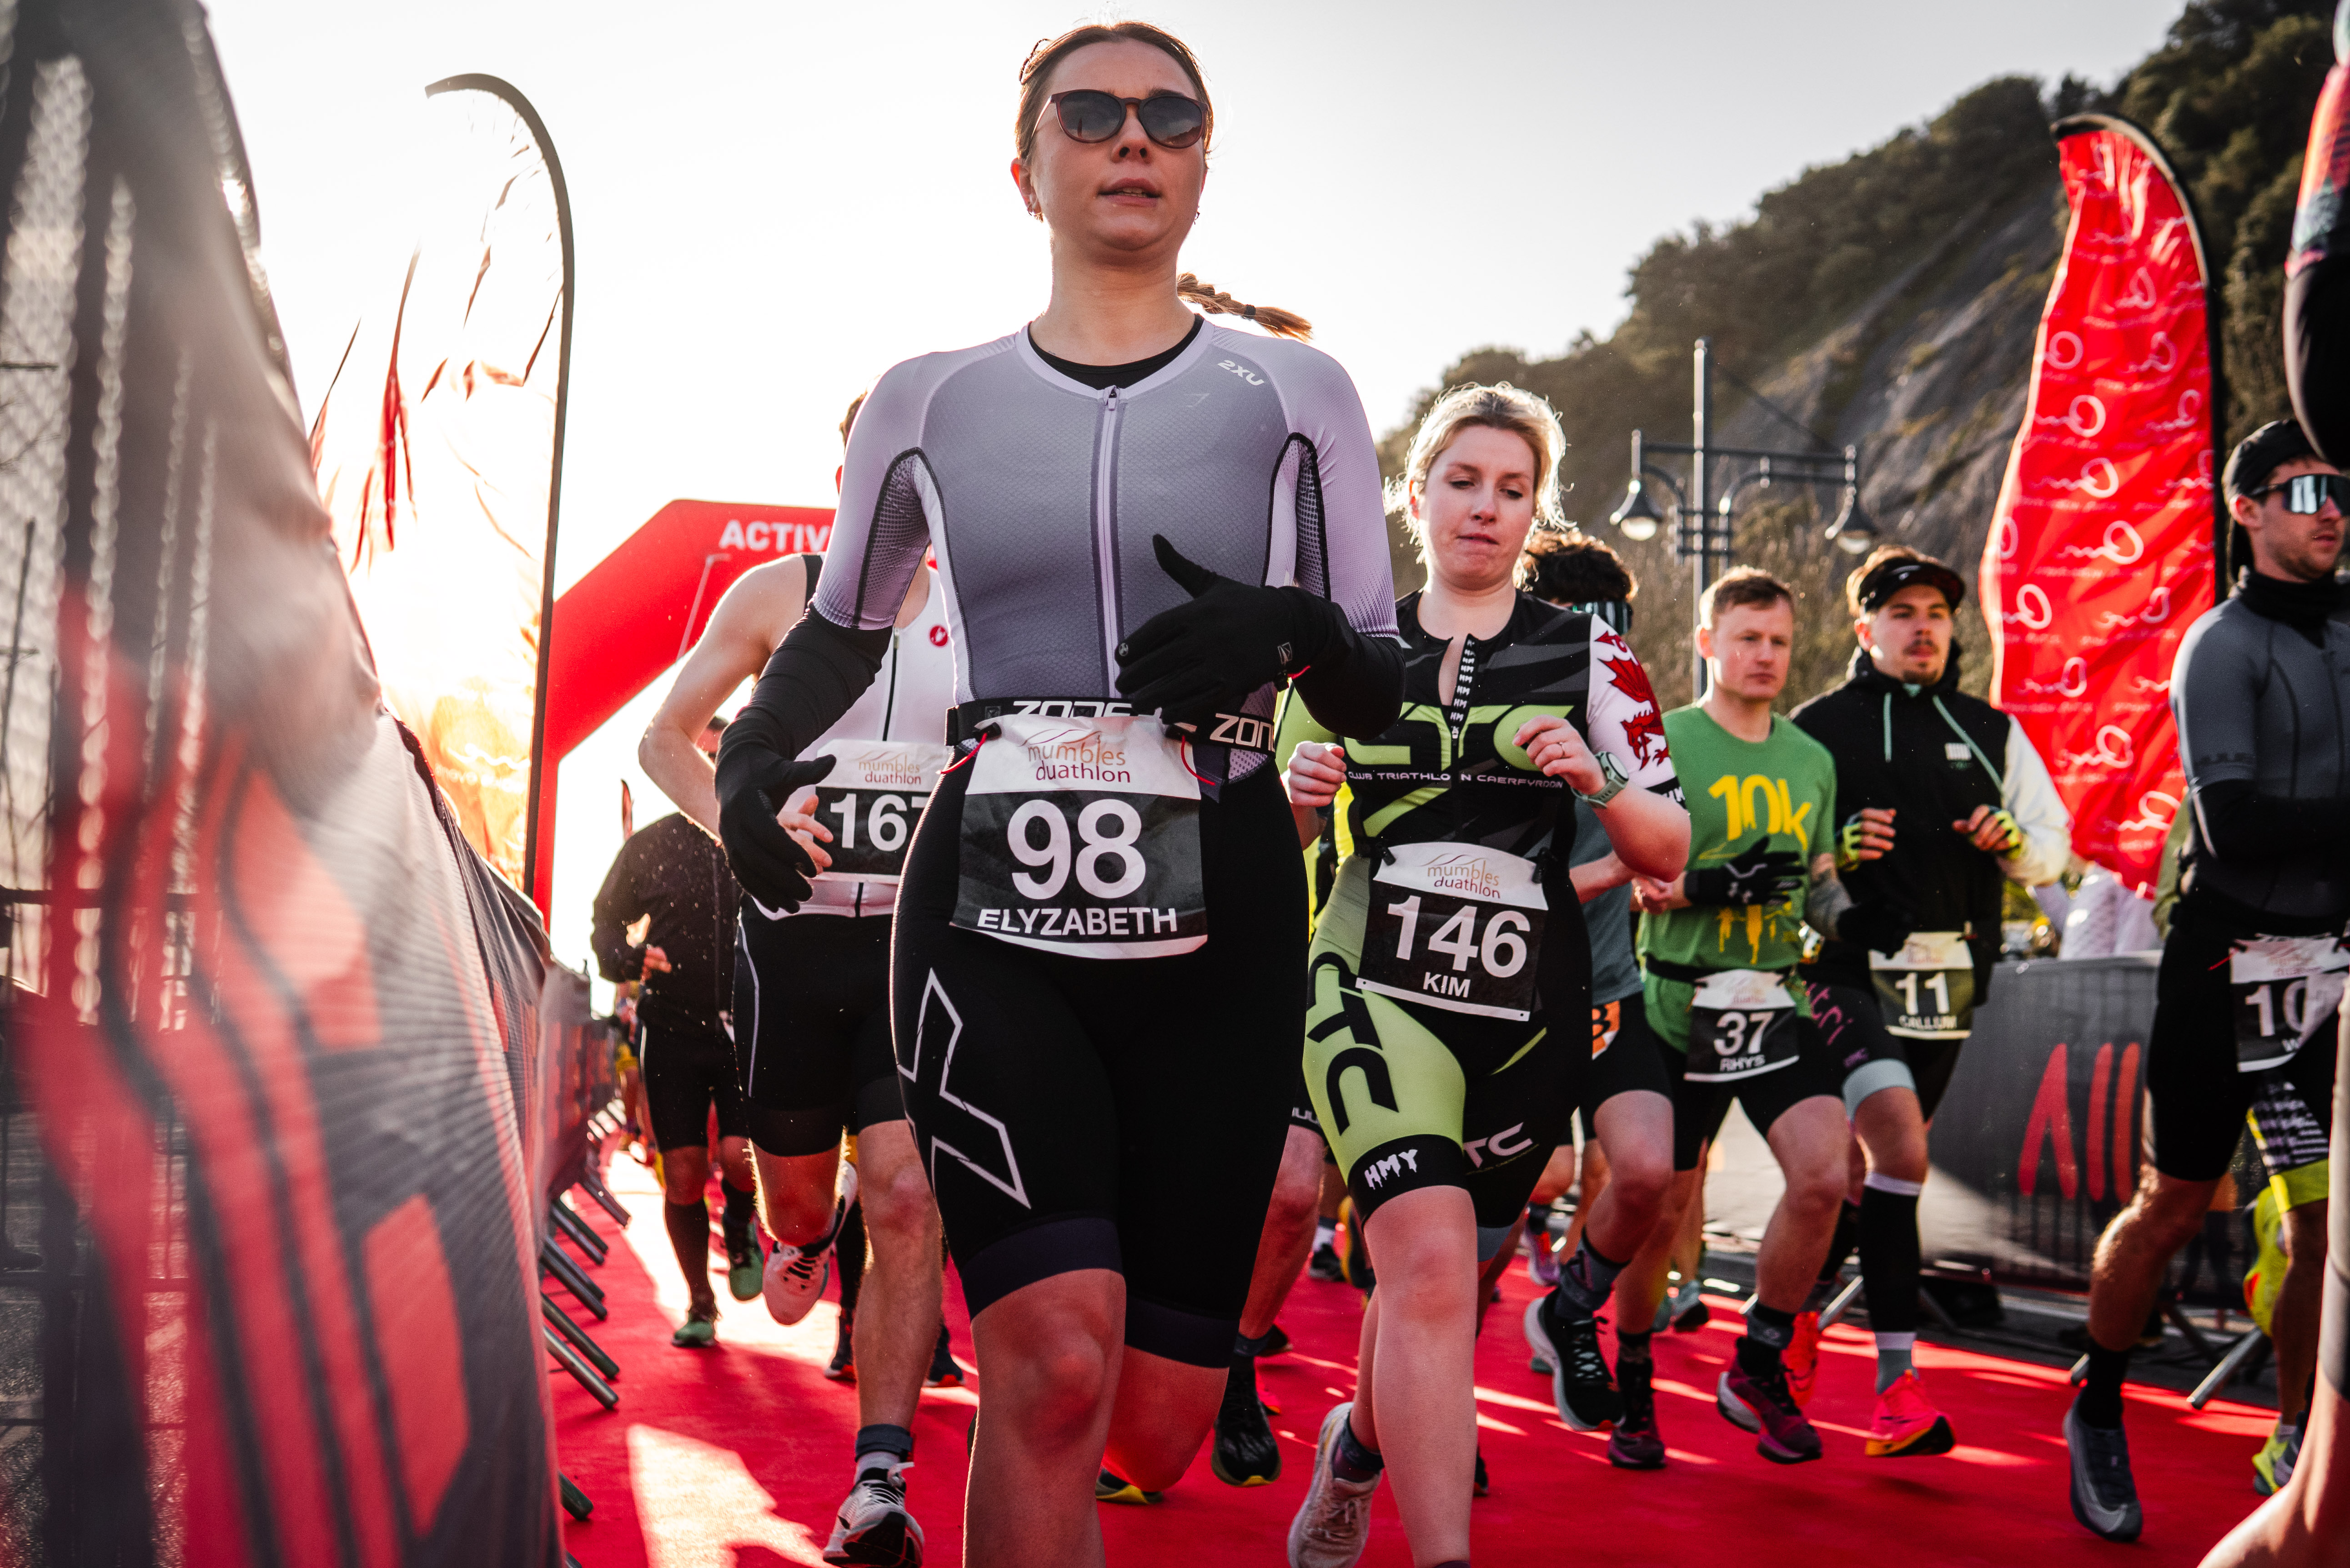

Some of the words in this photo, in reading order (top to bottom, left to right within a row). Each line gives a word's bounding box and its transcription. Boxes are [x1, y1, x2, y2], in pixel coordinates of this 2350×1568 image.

[1217, 359, 1265, 386] 2XU
[718, 519, 830, 553] ACTIV
[1209, 713, 1275, 753] ZON
[859, 753, 921, 774] mumbles
[1027, 735, 1126, 767] mumbles
[864, 770, 922, 785] duathlon
[1036, 765, 1131, 783] duathlon
[1007, 798, 1146, 900] 98
[1427, 859, 1500, 887] mumbles
[1434, 876, 1501, 899] duathlon
[977, 908, 1177, 937] ELYZABETH
[1387, 895, 1531, 978] 146
[1423, 972, 1471, 998] KIM
[1895, 971, 1950, 1016] 11
[1713, 1011, 1774, 1056] 37
[1719, 1054, 1766, 1072] RHYS
[1364, 1149, 1418, 1190] HMY
